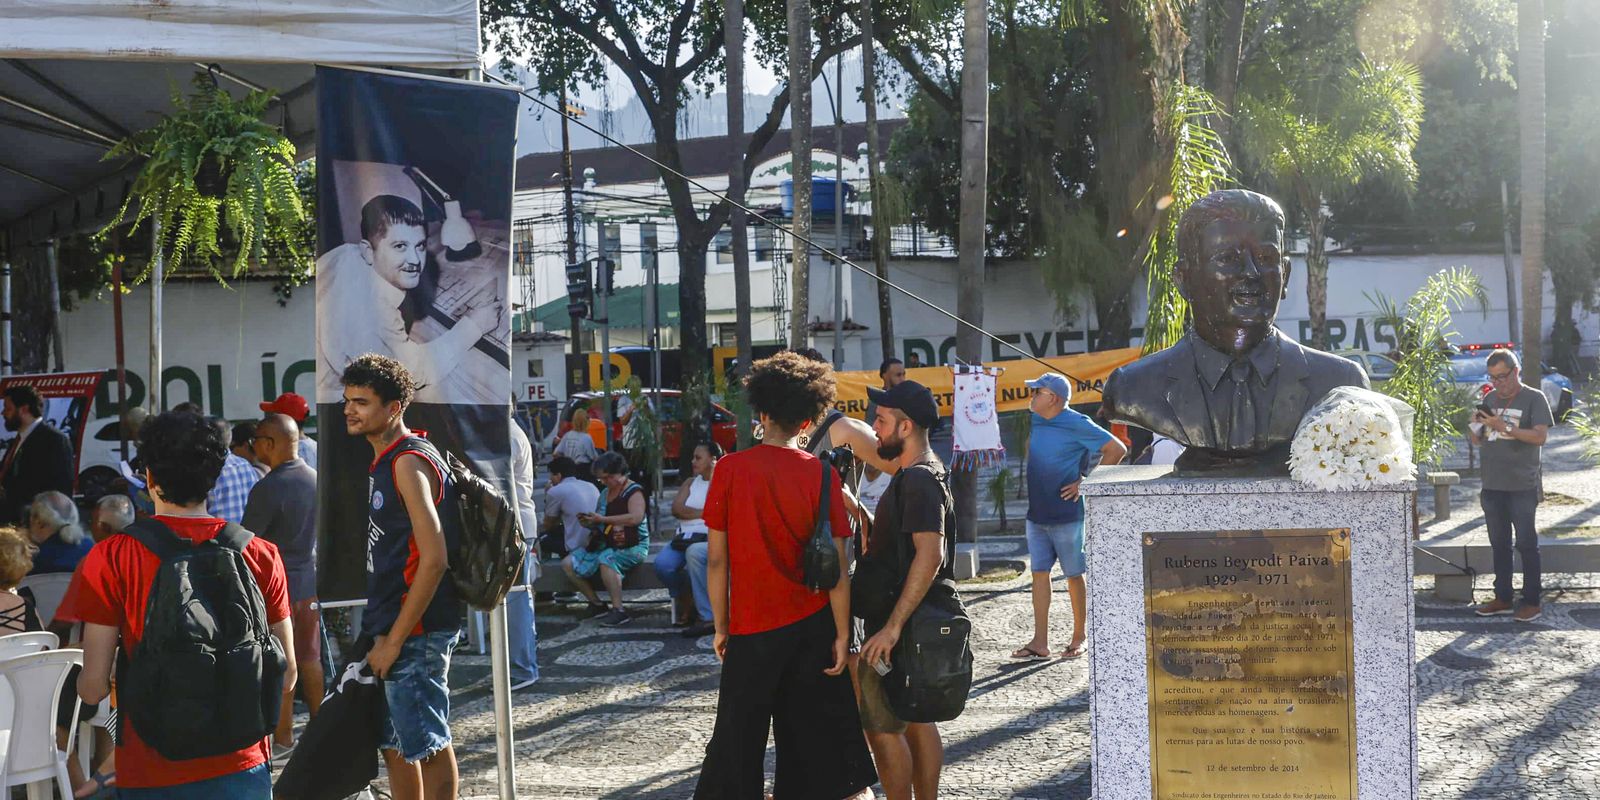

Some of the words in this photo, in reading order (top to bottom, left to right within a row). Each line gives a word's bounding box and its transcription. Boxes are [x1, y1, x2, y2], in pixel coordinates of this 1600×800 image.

[1298, 316, 1402, 351] BRAS
[95, 352, 317, 427] POLÍC
[528, 386, 545, 399] PE
[835, 399, 869, 414] GRU
[1076, 378, 1106, 392] MA
[1165, 555, 1217, 569] Rubens
[1224, 553, 1282, 571] Beyrodt
[1289, 553, 1329, 566] Paiva
[1205, 574, 1237, 586] 1929
[1258, 574, 1289, 585] 1971
[1188, 600, 1238, 609] Engenheiro
[1164, 686, 1205, 694] acreditou,
[1219, 688, 1235, 696] que
[1240, 686, 1263, 694] ainda
[1268, 686, 1286, 696] hoje
[1164, 697, 1209, 705] sentimento
[1214, 697, 1224, 705] de
[1229, 697, 1253, 706] nação
[1273, 697, 1293, 705] alma
[1228, 708, 1280, 718] homenagens.
[1192, 727, 1207, 735] Que
[1316, 727, 1340, 736] sejam
[1196, 739, 1214, 747] para
[1284, 739, 1305, 747] povo.
